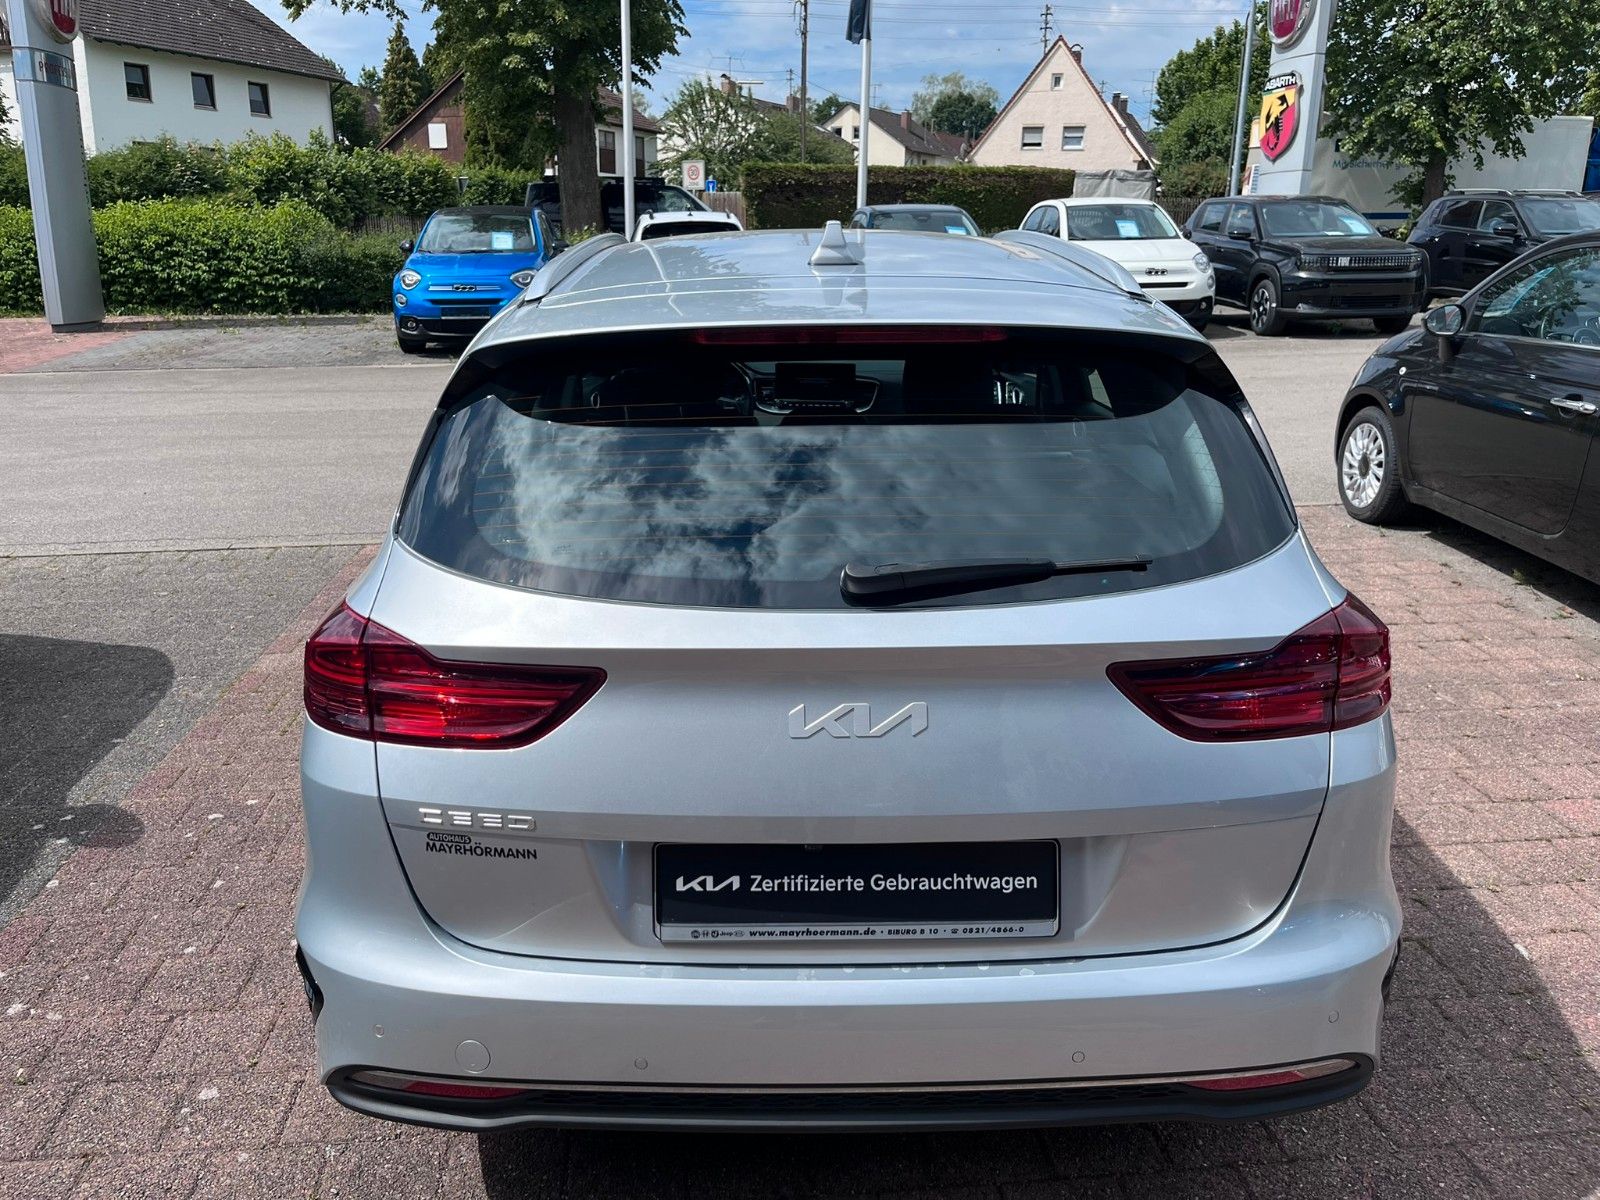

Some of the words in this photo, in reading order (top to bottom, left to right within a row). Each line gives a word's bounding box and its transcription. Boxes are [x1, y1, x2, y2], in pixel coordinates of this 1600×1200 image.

[1265, 75, 1296, 90] ABARTH
[789, 702, 928, 739] KIA
[428, 833, 470, 843] AUTOHAUS
[425, 842, 538, 860] MAYRHÖRMANN
[676, 875, 740, 891] KIA
[750, 874, 865, 892] Zertifizierte
[870, 873, 1038, 894] Gebrauchtwagen
[749, 927, 876, 938] www.mayrhoermann.de
[888, 928, 917, 936] BIBURG
[962, 926, 1025, 935] 0821/4866-0
